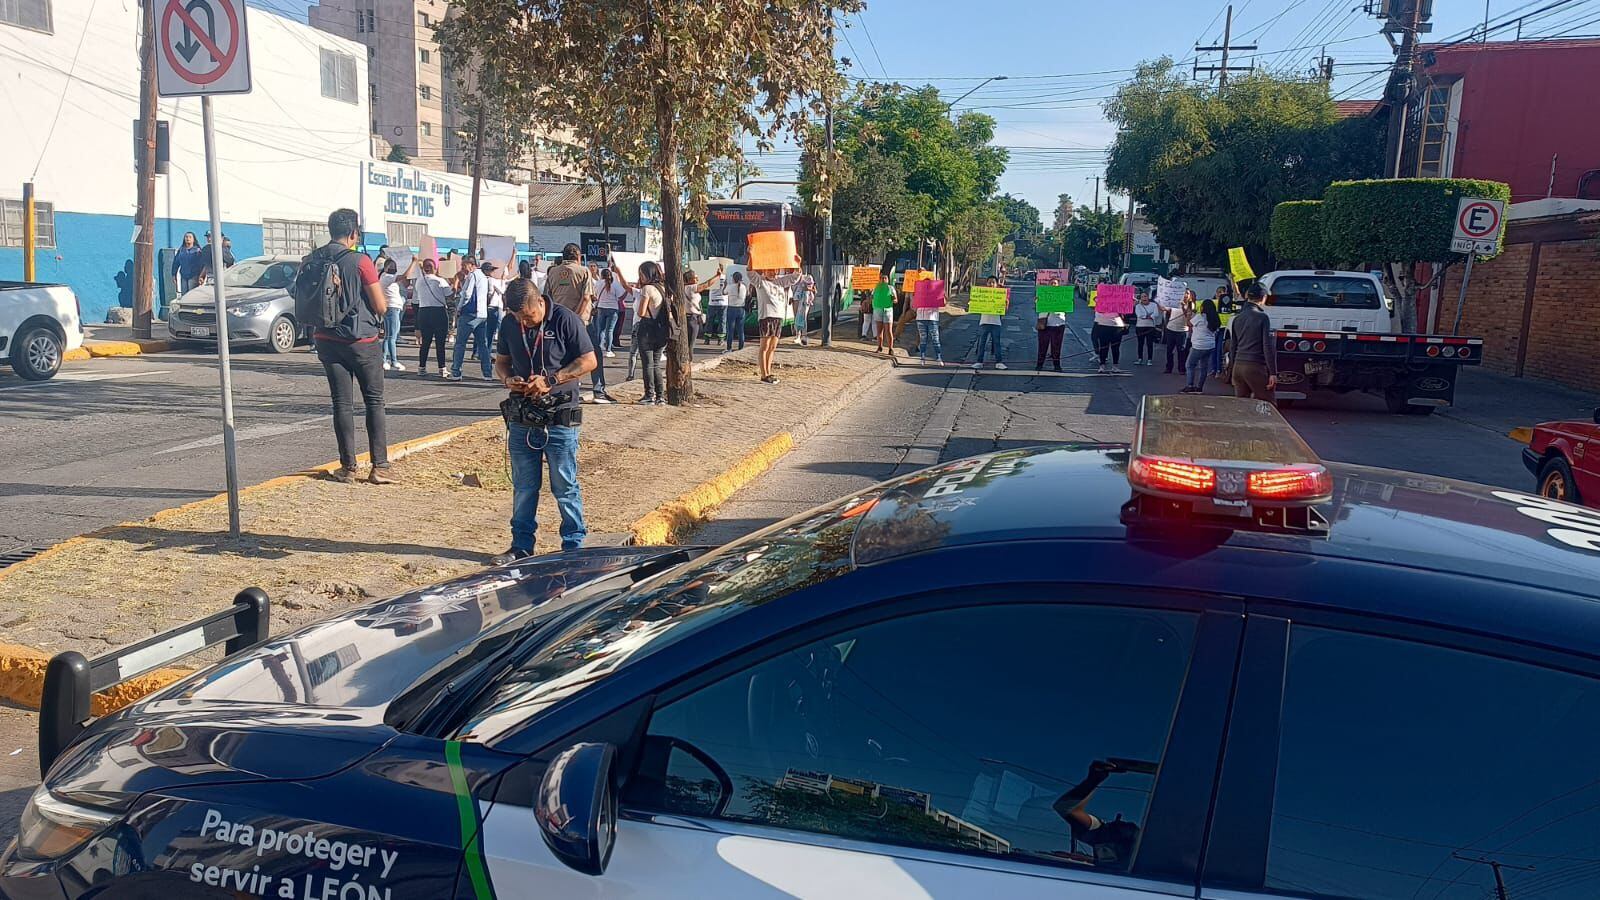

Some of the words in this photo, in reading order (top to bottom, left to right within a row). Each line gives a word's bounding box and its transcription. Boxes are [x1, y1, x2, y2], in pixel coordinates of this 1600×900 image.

[384, 191, 408, 215] JOSE
[411, 195, 434, 218] PONS
[1468, 207, 1489, 231] E
[1421, 378, 1445, 390] Ford
[200, 808, 255, 847] Para
[257, 828, 378, 871] proteger
[379, 849, 399, 879] y
[189, 862, 273, 896] servir
[278, 877, 295, 899] a
[303, 873, 392, 900] LEÓN
